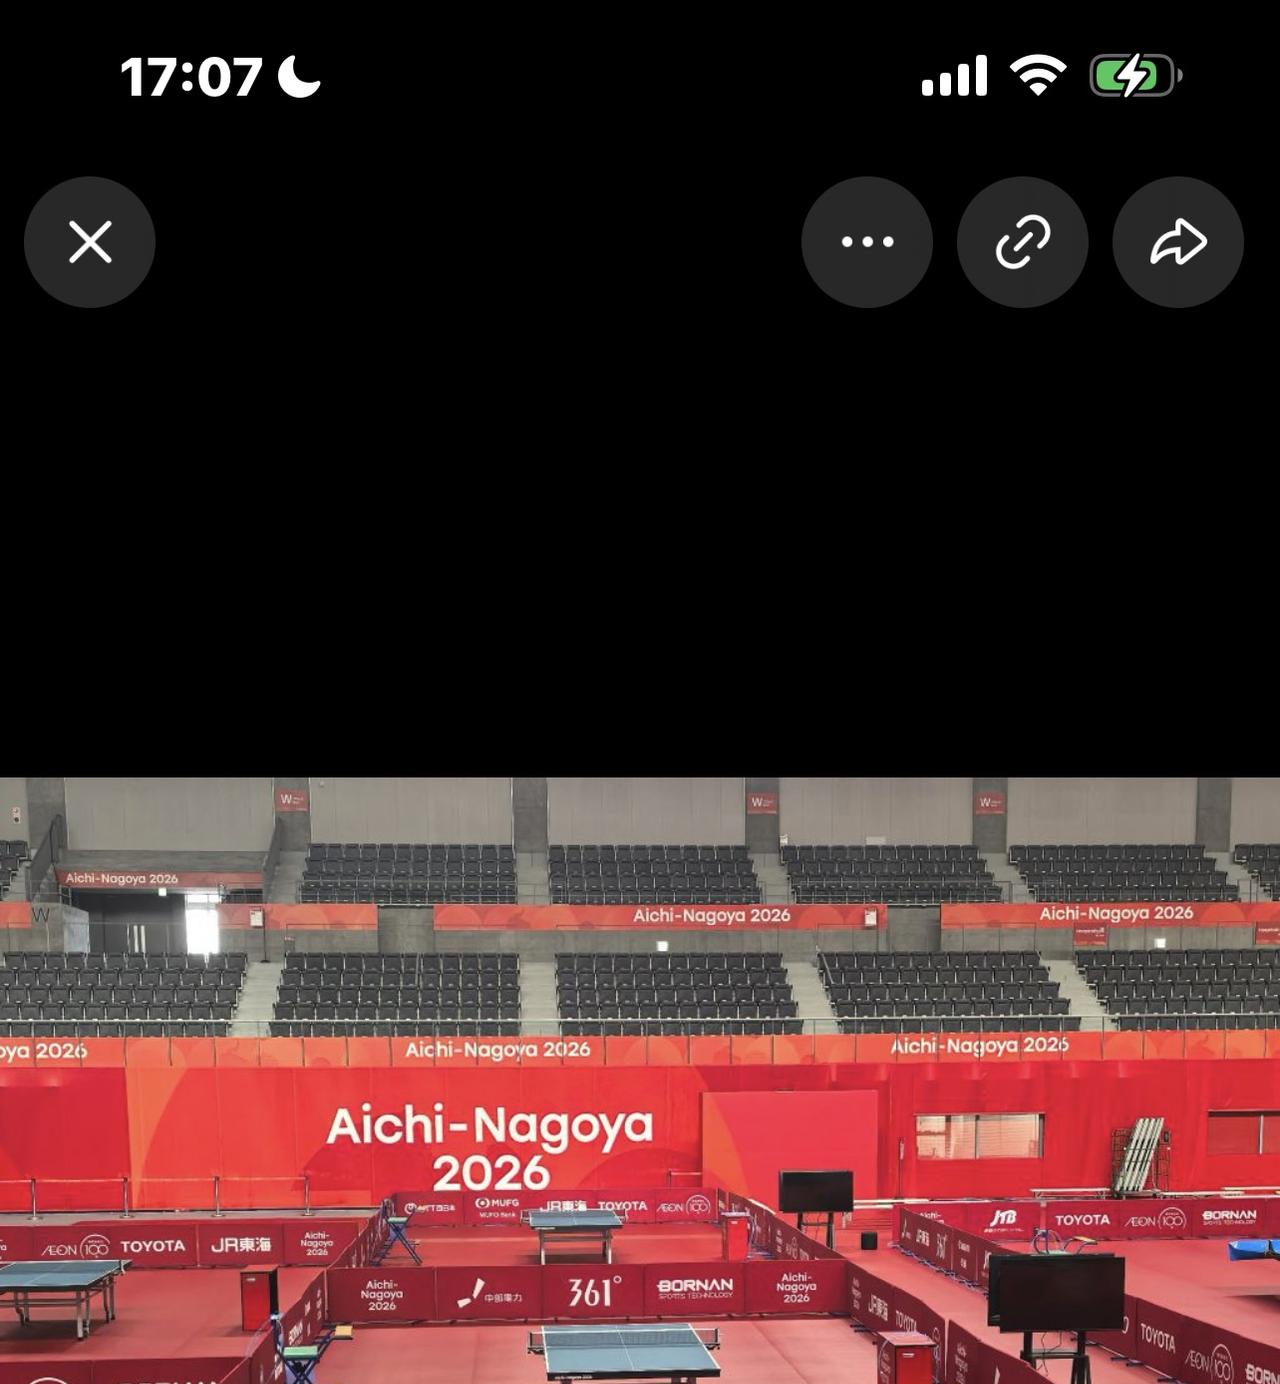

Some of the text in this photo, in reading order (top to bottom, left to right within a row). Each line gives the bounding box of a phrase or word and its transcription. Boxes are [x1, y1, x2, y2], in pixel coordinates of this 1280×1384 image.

[65, 873, 178, 887] Aichi-Nagoya 2026
[633, 907, 790, 925] Aichi-Nagoya 2026
[1040, 903, 1194, 923] Aichi-Nagoya 2026
[36, 1043, 87, 1058] 2026
[405, 1041, 590, 1062] Aichi-Nagoya 2026
[891, 1037, 1069, 1057] Aichi-Nagoya 2026
[326, 1102, 653, 1155] Aichi-Nagoya
[433, 1155, 551, 1192] 2026
[490, 1198, 521, 1208] MUFG
[598, 1200, 648, 1211] TOYOTA
[990, 1210, 1016, 1227] JTB
[1055, 1215, 1110, 1225] TOYOTA
[1160, 1214, 1184, 1226] 100
[1202, 1210, 1256, 1221] BORNAN
[303, 1230, 331, 1240] Aichi-
[83, 1243, 110, 1256] 100
[121, 1240, 185, 1252] TOYOTA
[212, 1237, 271, 1252] JR東海
[300, 1239, 334, 1248] Nagoya
[780, 1271, 814, 1283] Aichi-
[364, 1278, 400, 1291] Aichi-
[657, 1279, 733, 1292] BORNAN
[775, 1282, 818, 1294] Nagoya
[360, 1288, 404, 1303] Nagoya
[782, 1293, 812, 1304] 2026
[366, 1300, 398, 1312] 2026
[1141, 1323, 1175, 1353] TOYOTA
[1214, 1358, 1231, 1382] 100
